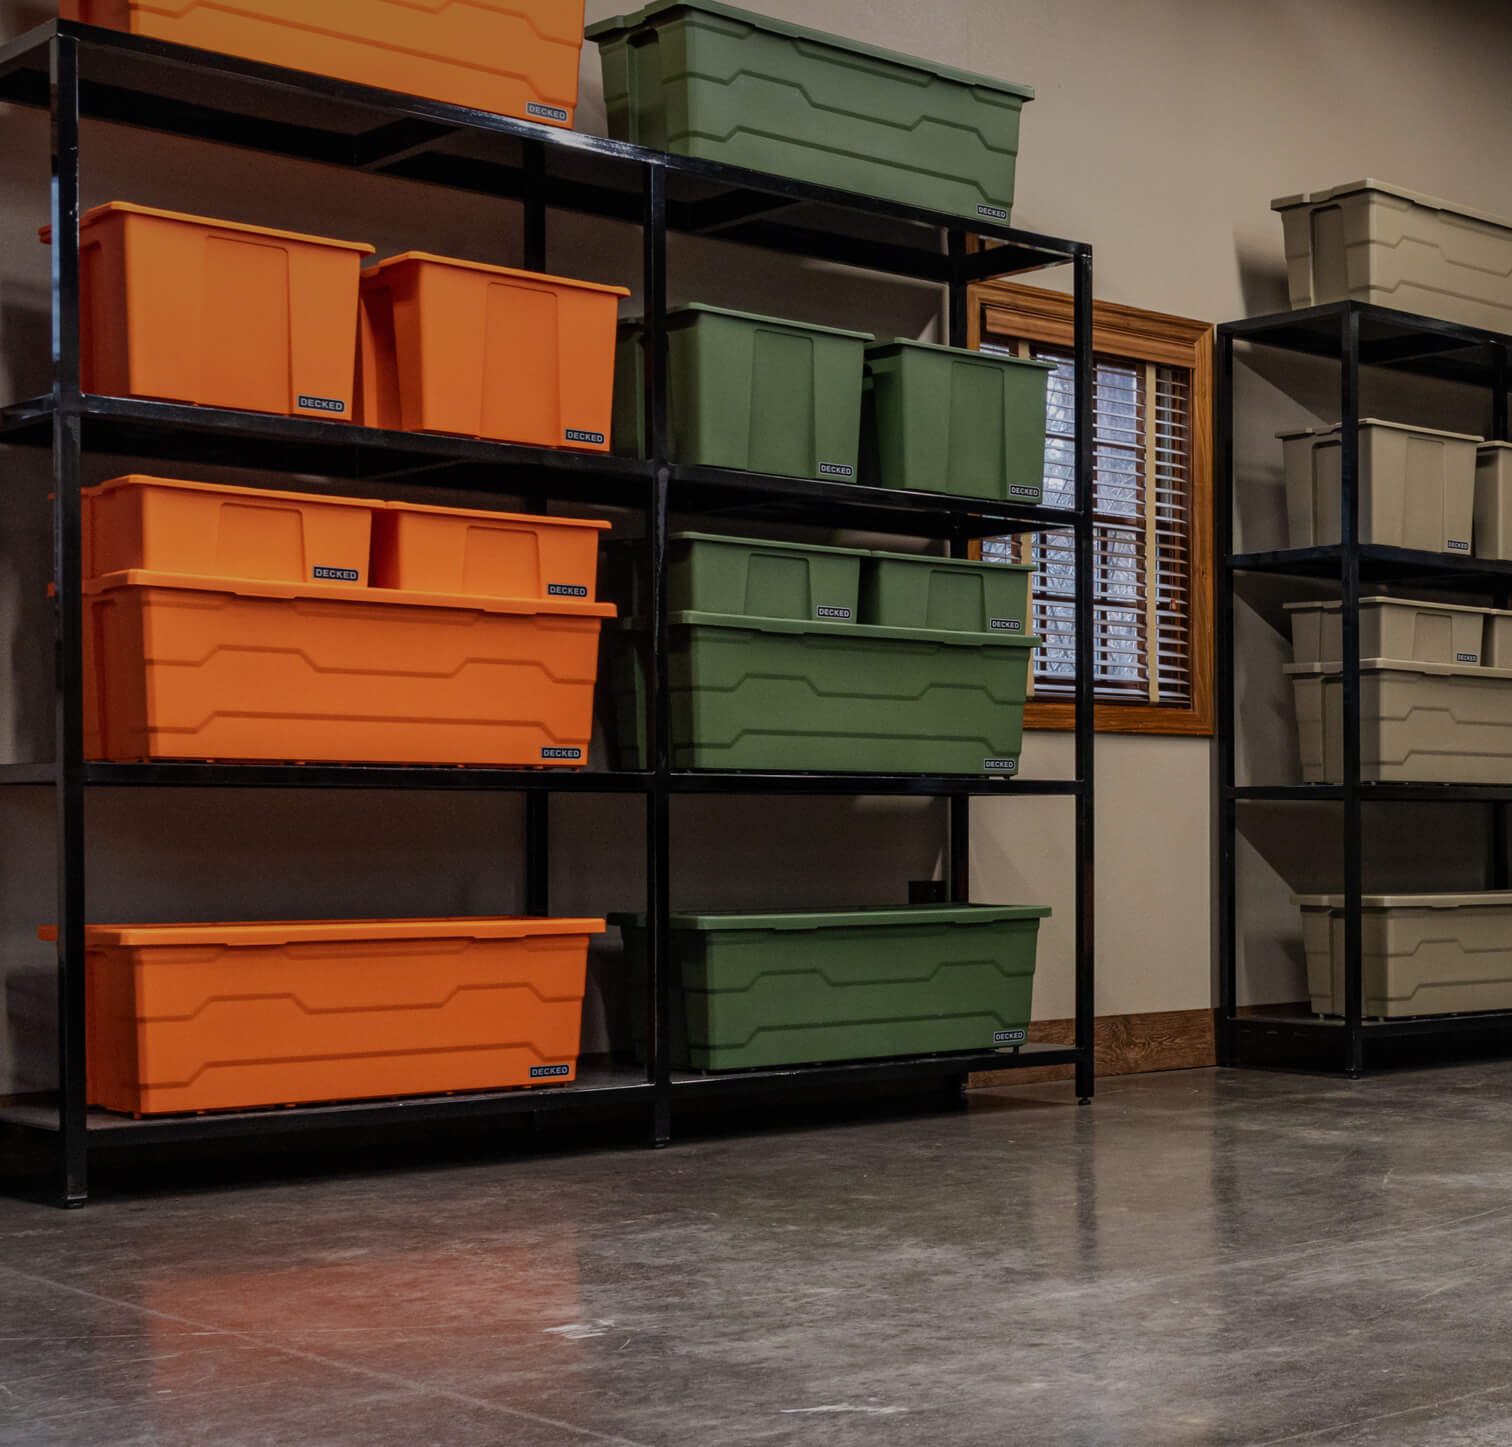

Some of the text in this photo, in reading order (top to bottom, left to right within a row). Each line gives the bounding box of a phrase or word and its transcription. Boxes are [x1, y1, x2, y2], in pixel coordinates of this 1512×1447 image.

[529, 104, 566, 119] DECKED
[976, 205, 1006, 219] DECKED
[299, 397, 344, 411] DECKED
[566, 430, 603, 443] DECKED
[820, 465, 851, 475] DECKED
[1010, 486, 1038, 497] DECKED
[315, 568, 357, 580] DECKED
[548, 586, 586, 596] DECKED
[818, 608, 850, 617] DECKED
[991, 620, 1020, 629] DECKED
[542, 749, 580, 758] DECKED
[985, 760, 1014, 768] DECKED
[994, 1031, 1023, 1041] DECKED
[530, 1066, 568, 1076] DECKED
